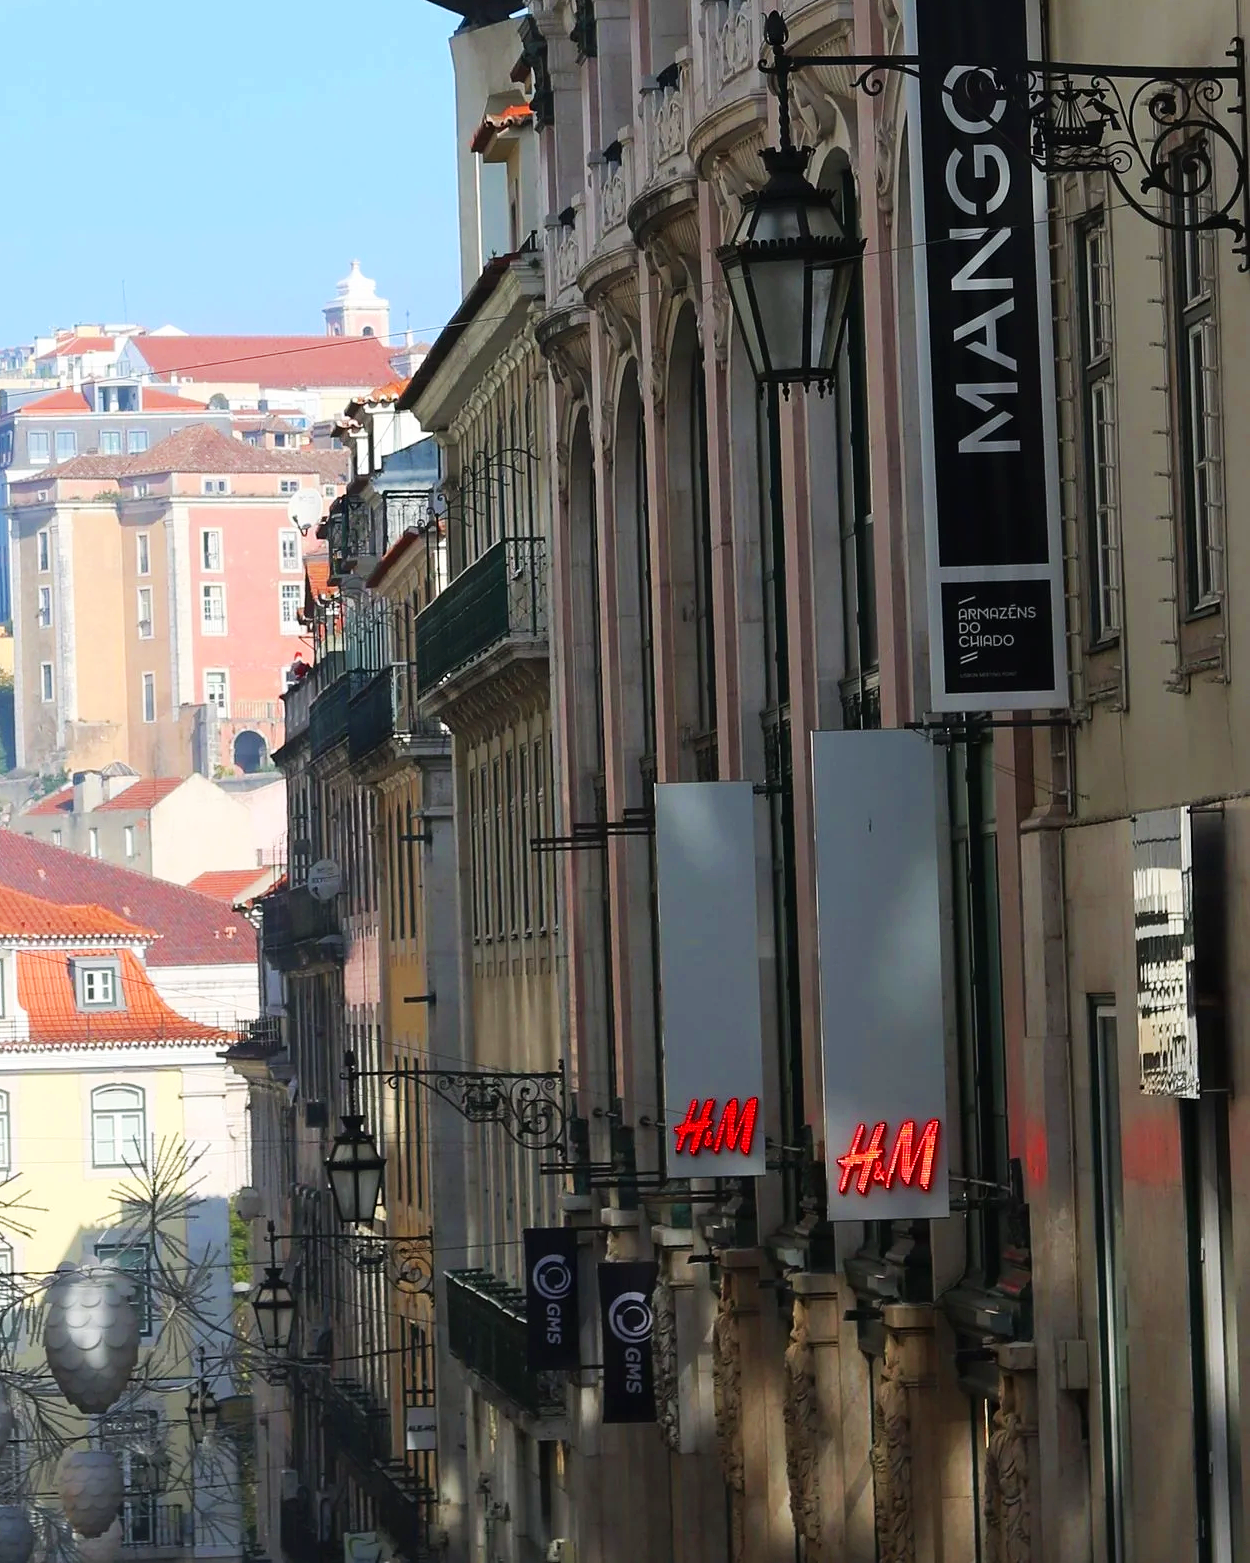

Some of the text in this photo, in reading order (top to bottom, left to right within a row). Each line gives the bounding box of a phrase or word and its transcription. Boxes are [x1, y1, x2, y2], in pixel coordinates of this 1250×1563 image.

[943, 64, 1021, 453] MANGO
[958, 604, 1036, 620] ARMAZÉNS
[958, 621, 981, 634] DO
[958, 634, 1015, 648] CHIADO
[673, 1097, 759, 1156] H&M
[837, 1118, 941, 1196] H&M
[546, 1303, 562, 1345] GMS
[624, 1346, 642, 1394] GMS
